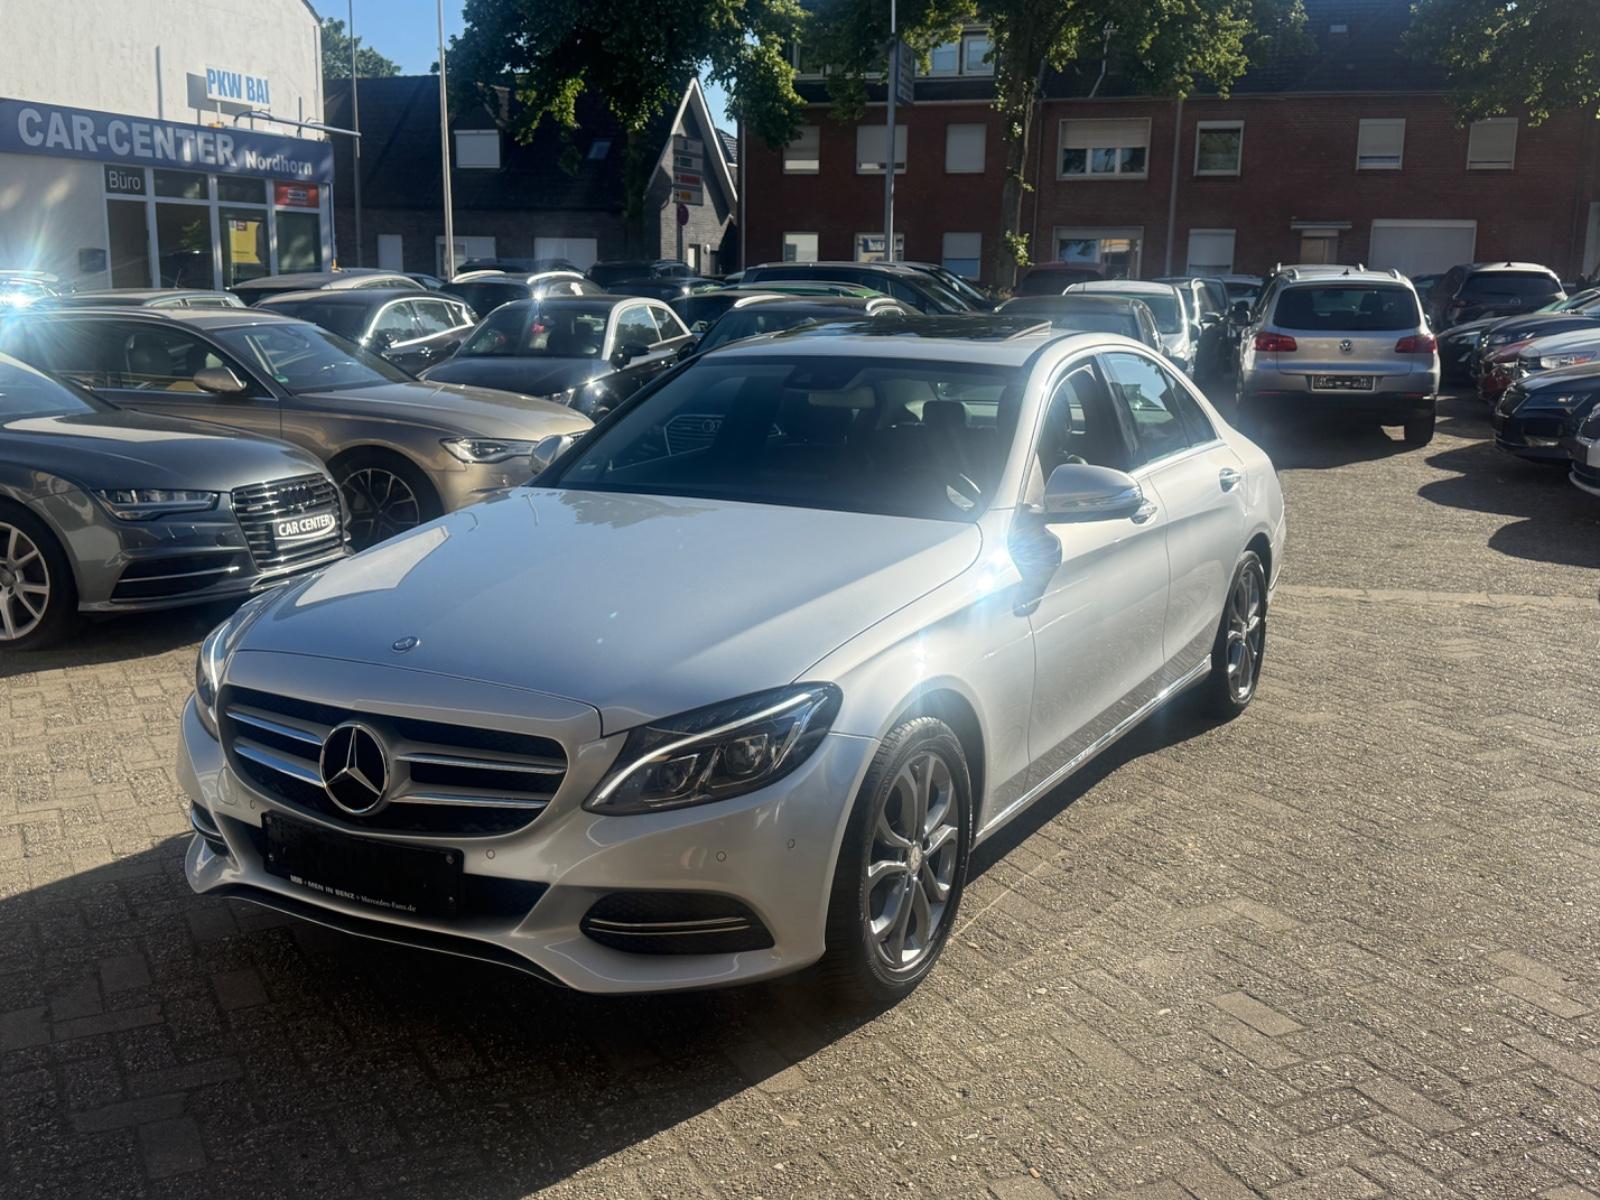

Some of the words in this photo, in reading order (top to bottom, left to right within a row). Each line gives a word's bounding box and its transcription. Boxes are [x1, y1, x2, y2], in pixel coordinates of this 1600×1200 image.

[206, 68, 242, 99] PKW
[17, 108, 237, 167] CAR-CENTER
[245, 150, 313, 175] Nordhorn
[108, 170, 141, 190] Büro
[278, 521, 300, 536] CAR
[299, 514, 330, 533] CENTER
[307, 880, 324, 891] MEN
[325, 885, 334, 894] IN
[335, 888, 355, 900] BENZ
